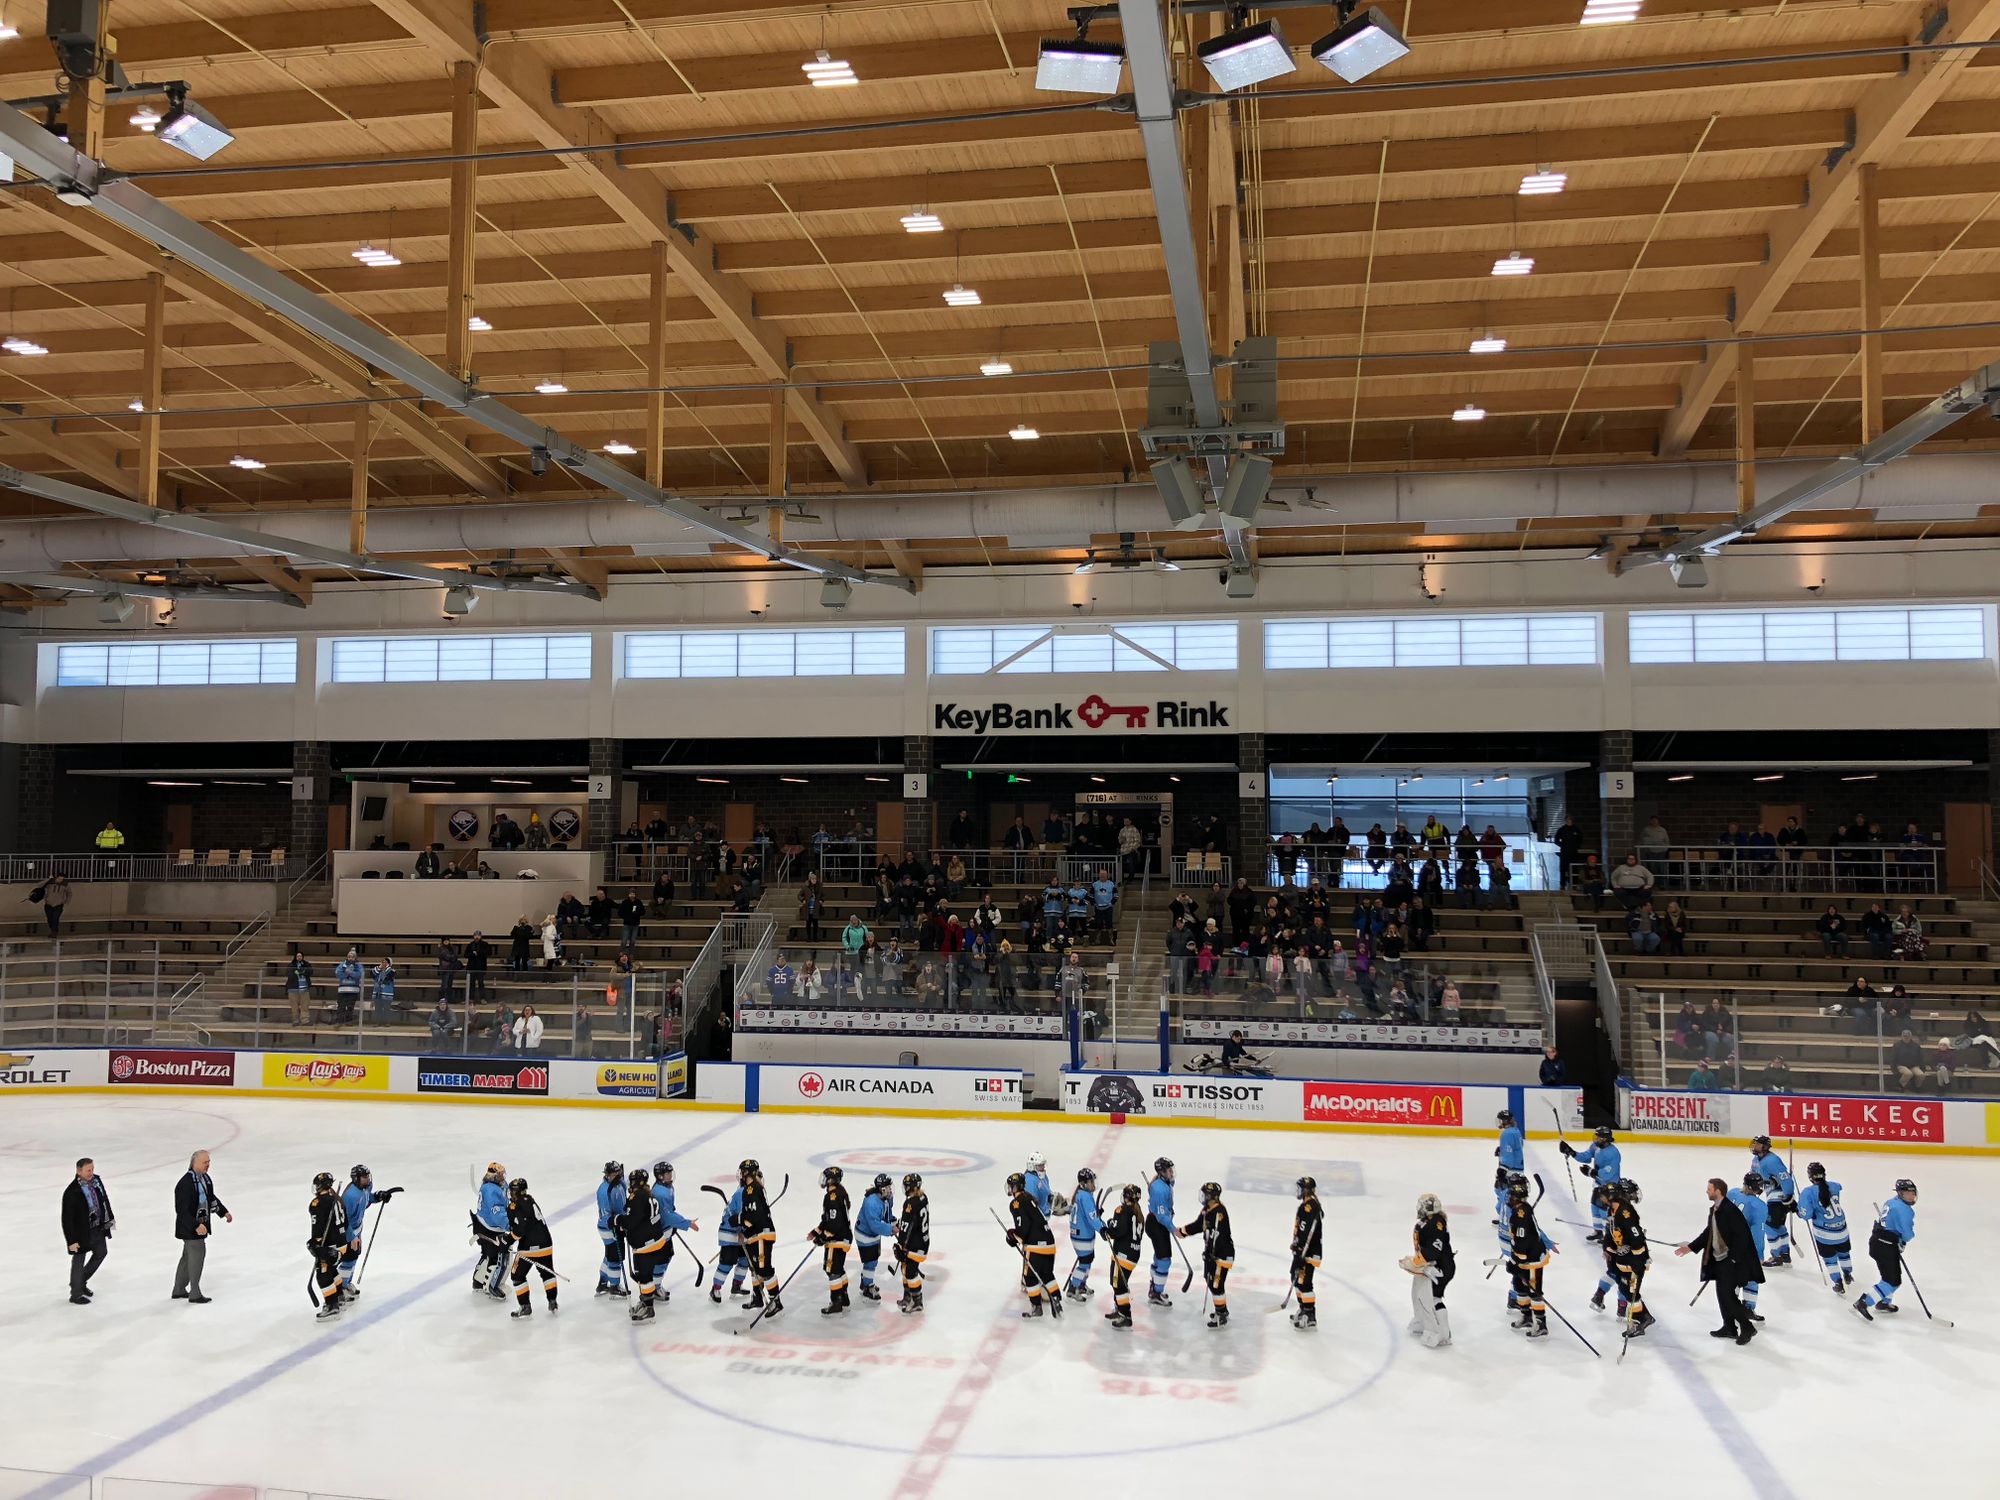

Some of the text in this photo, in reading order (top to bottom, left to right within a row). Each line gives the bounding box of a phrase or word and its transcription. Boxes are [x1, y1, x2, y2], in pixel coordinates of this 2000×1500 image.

[935, 701, 1229, 734] KeyBank Rink
[300, 784, 305, 793] 1
[597, 783, 603, 792] 2
[912, 781, 919, 791] 3
[1249, 780, 1256, 790] 4
[1616, 780, 1624, 790] 5
[774, 973, 787, 984] 25
[311, 1062, 340, 1078] Lay's
[619, 1073, 640, 1081] NEW
[420, 1073, 514, 1088] TIMBER MART
[828, 1079, 934, 1094] AIR CANADA
[1065, 1081, 1081, 1094] T
[1184, 1085, 1263, 1101] TISSOT
[1310, 1094, 1423, 1113] McDonald's
[1780, 1102, 1929, 1124] THE KEG
[650, 1342, 797, 1359] UNITED
[725, 1361, 860, 1380] Buffalo
